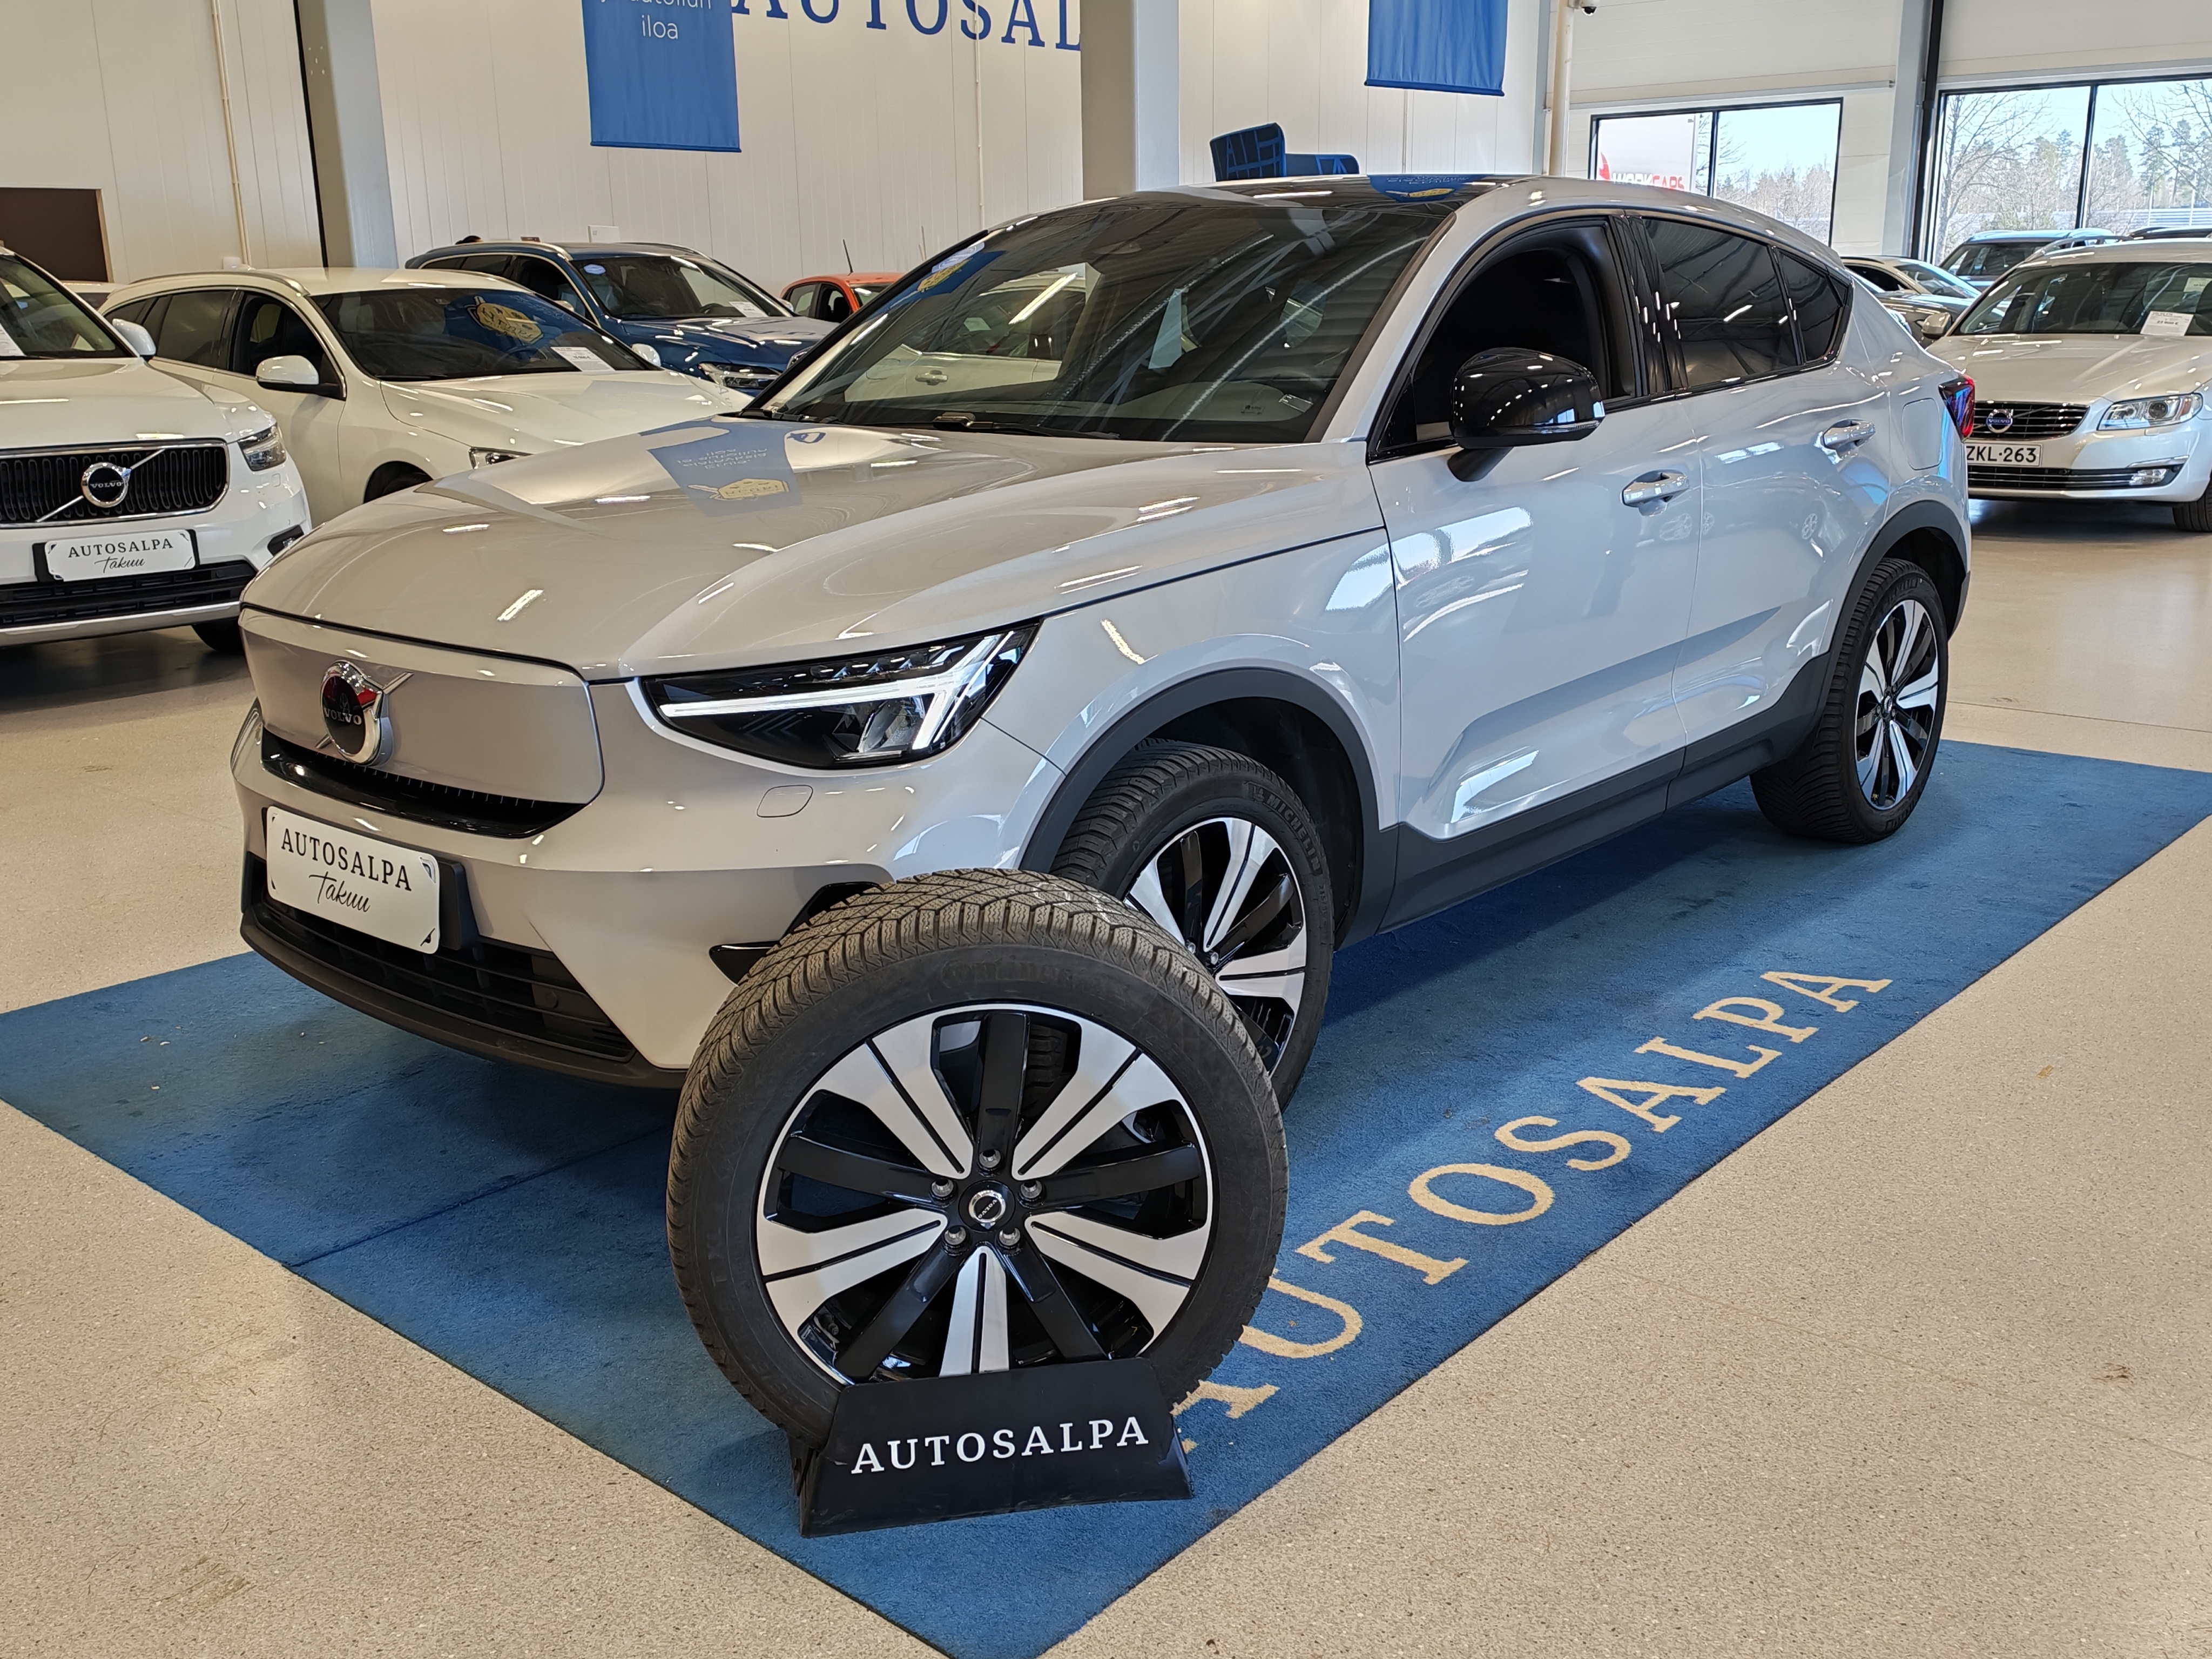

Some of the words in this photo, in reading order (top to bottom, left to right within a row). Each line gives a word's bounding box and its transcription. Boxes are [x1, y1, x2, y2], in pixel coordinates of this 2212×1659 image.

[641, 14, 678, 40] iloa
[1966, 446, 2036, 463] ZKL-263
[90, 481, 124, 489] VOLVO
[68, 538, 174, 558] AUTOSALPA
[94, 556, 145, 574] Takuu
[323, 706, 362, 725] VOLVO
[1266, 794, 1321, 872] MICHELIN
[281, 828, 412, 892] AUTOSALPA
[308, 871, 371, 913] Takuu
[977, 1199, 998, 1218] VOLVO
[851, 1415, 1149, 1474] AUTOSALPA
